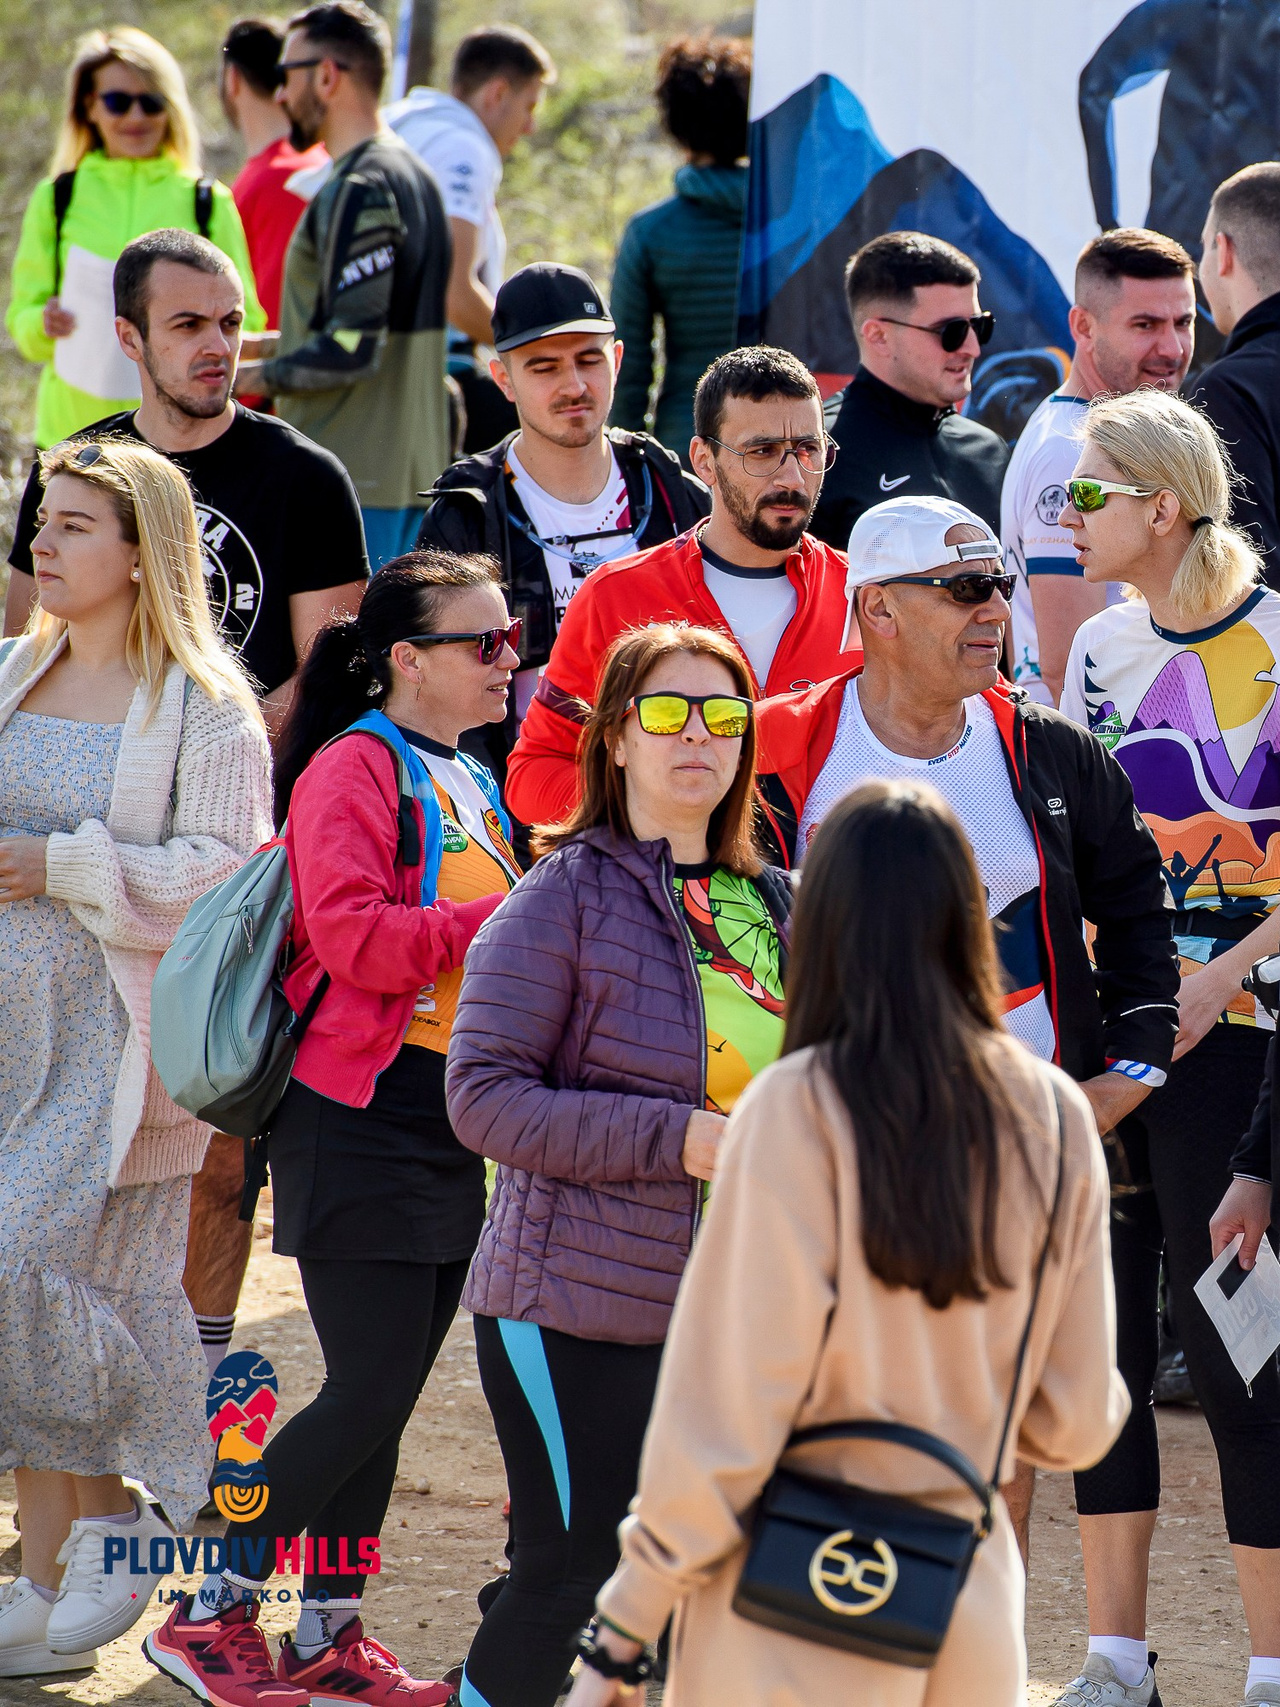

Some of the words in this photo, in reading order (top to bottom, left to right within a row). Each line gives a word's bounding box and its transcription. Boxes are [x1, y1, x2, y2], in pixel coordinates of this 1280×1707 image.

[235, 583, 254, 610] 2
[928, 755, 947, 765] EVERY
[947, 745, 960, 758] STEP
